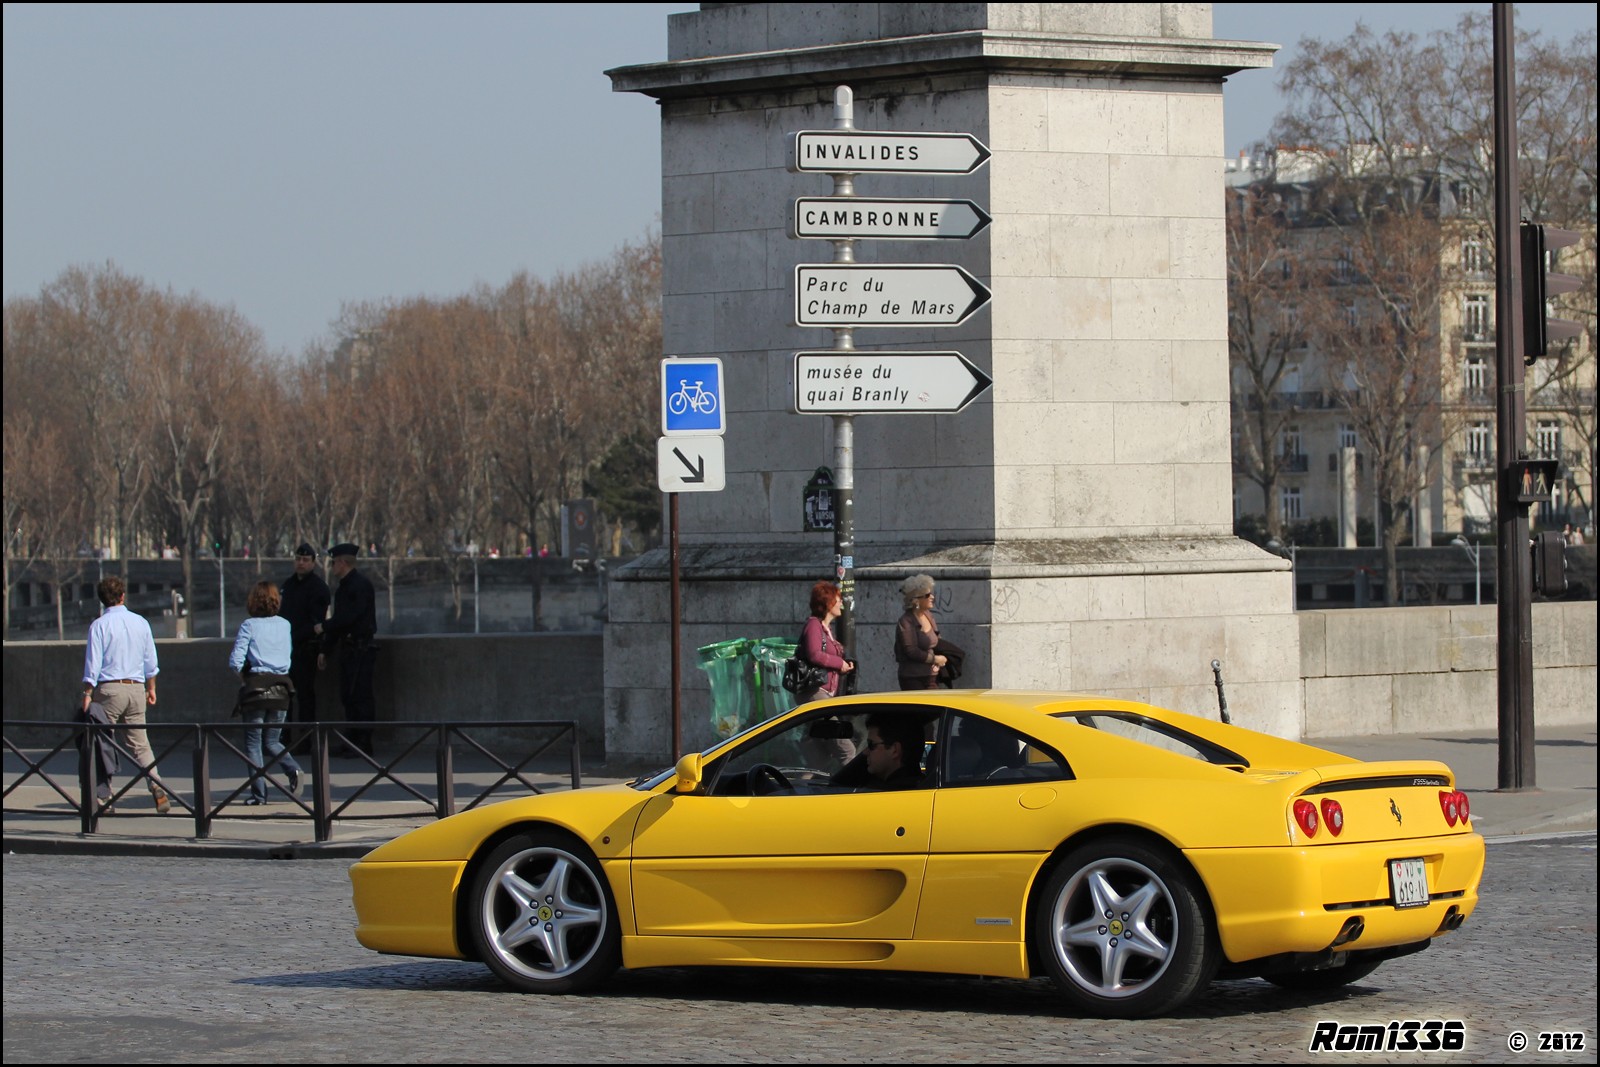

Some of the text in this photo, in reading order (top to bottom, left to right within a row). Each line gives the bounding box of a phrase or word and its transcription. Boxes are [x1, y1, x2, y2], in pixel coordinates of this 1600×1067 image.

[806, 144, 919, 161] INVALIDES
[805, 210, 940, 227] CAMBRONNE
[806, 276, 884, 292] Parc du
[807, 299, 955, 318] Champ de Mars
[807, 364, 892, 379] musée du
[807, 386, 909, 405] quai Branly
